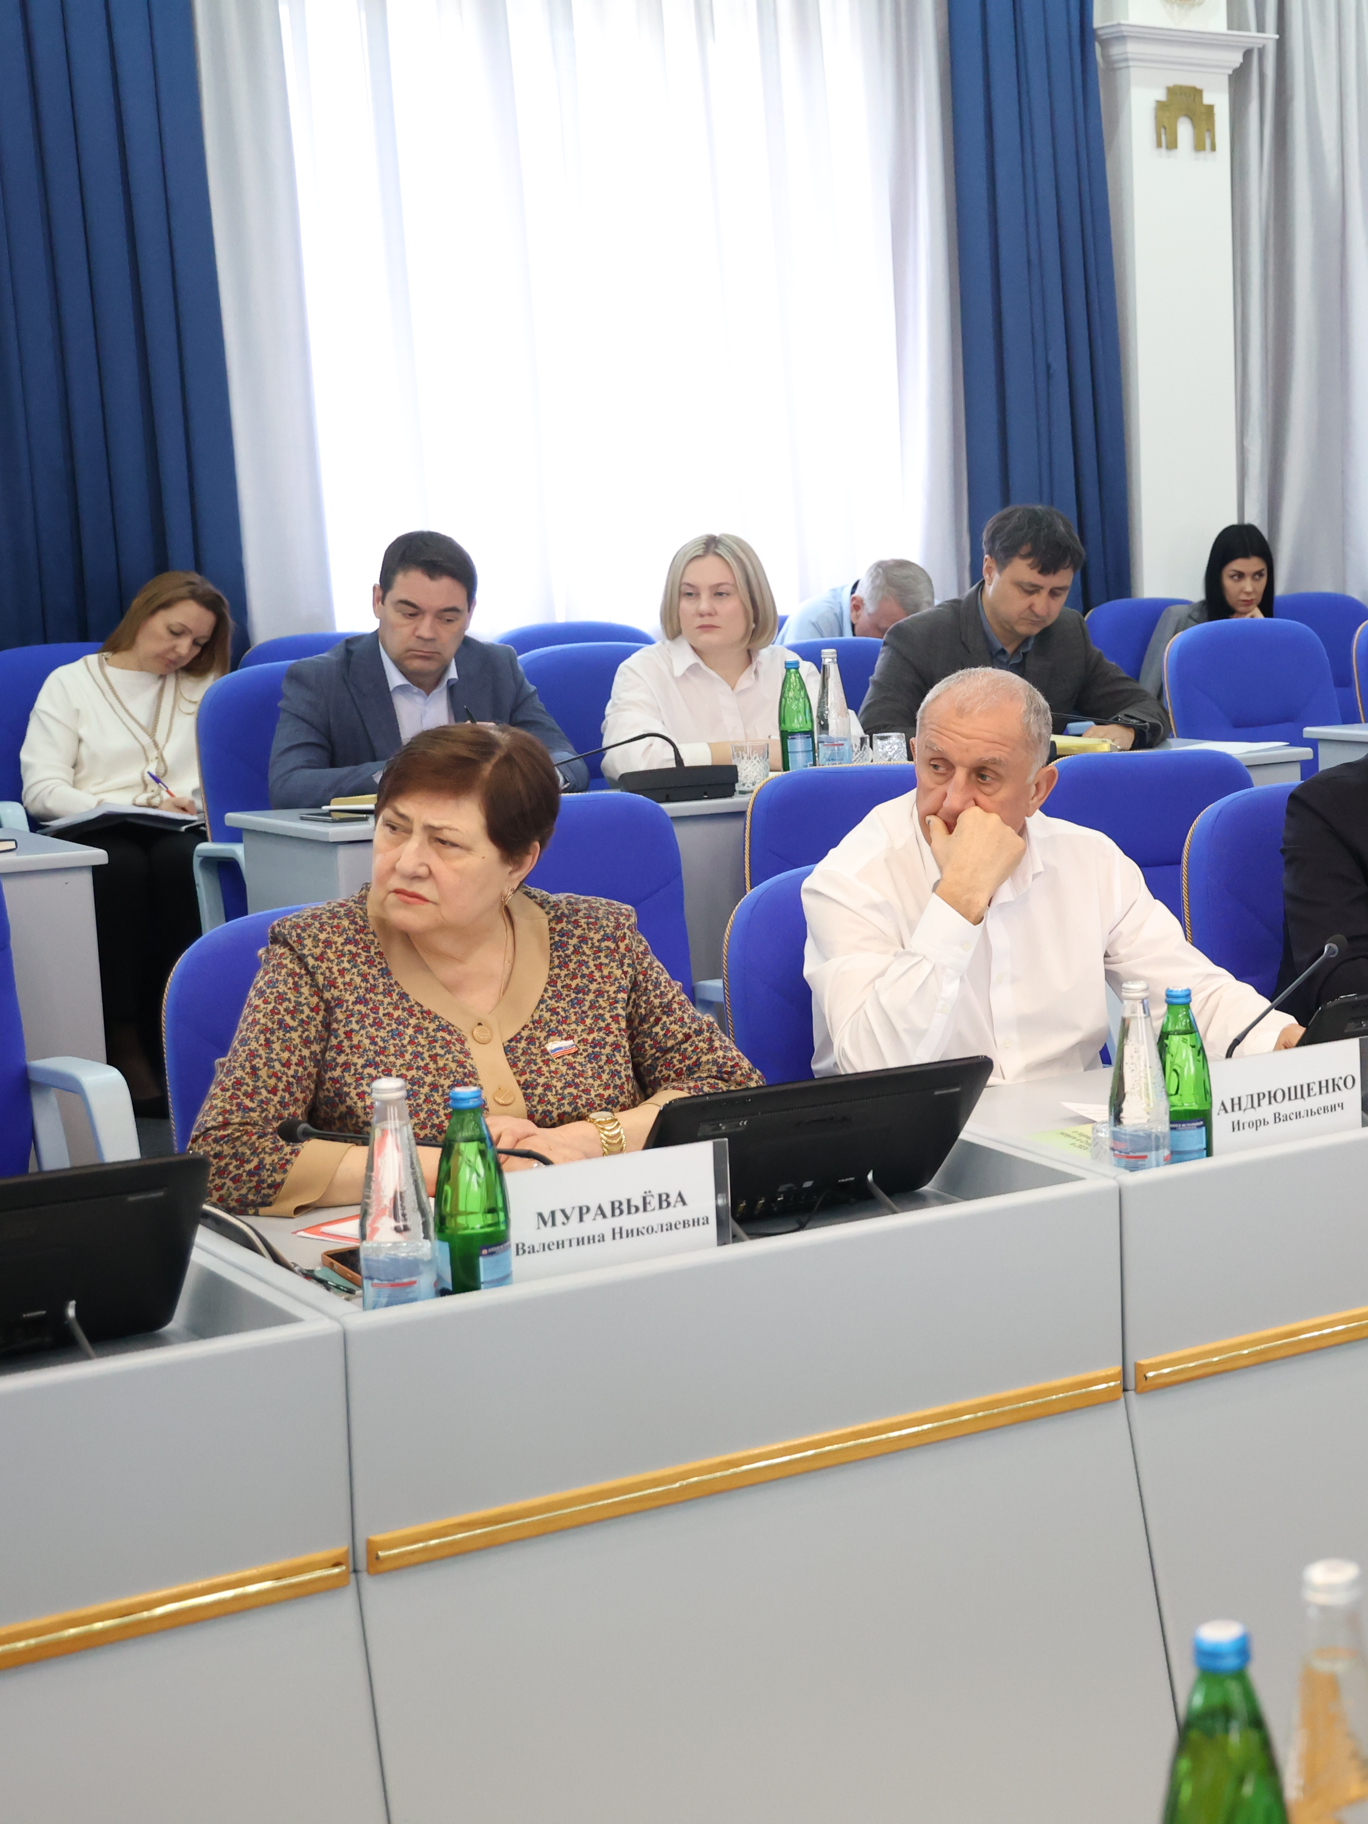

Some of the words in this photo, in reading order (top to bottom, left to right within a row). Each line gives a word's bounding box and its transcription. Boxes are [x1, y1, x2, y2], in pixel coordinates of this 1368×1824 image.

[1217, 1074, 1356, 1115] АНДРЮЩЕНКО
[1231, 1117, 1269, 1133] Игорь
[1273, 1101, 1344, 1124] Васильевич
[536, 1190, 688, 1230] МУРАВЬЁВА
[515, 1232, 606, 1257] Валентина
[611, 1215, 710, 1241] Николаевна
